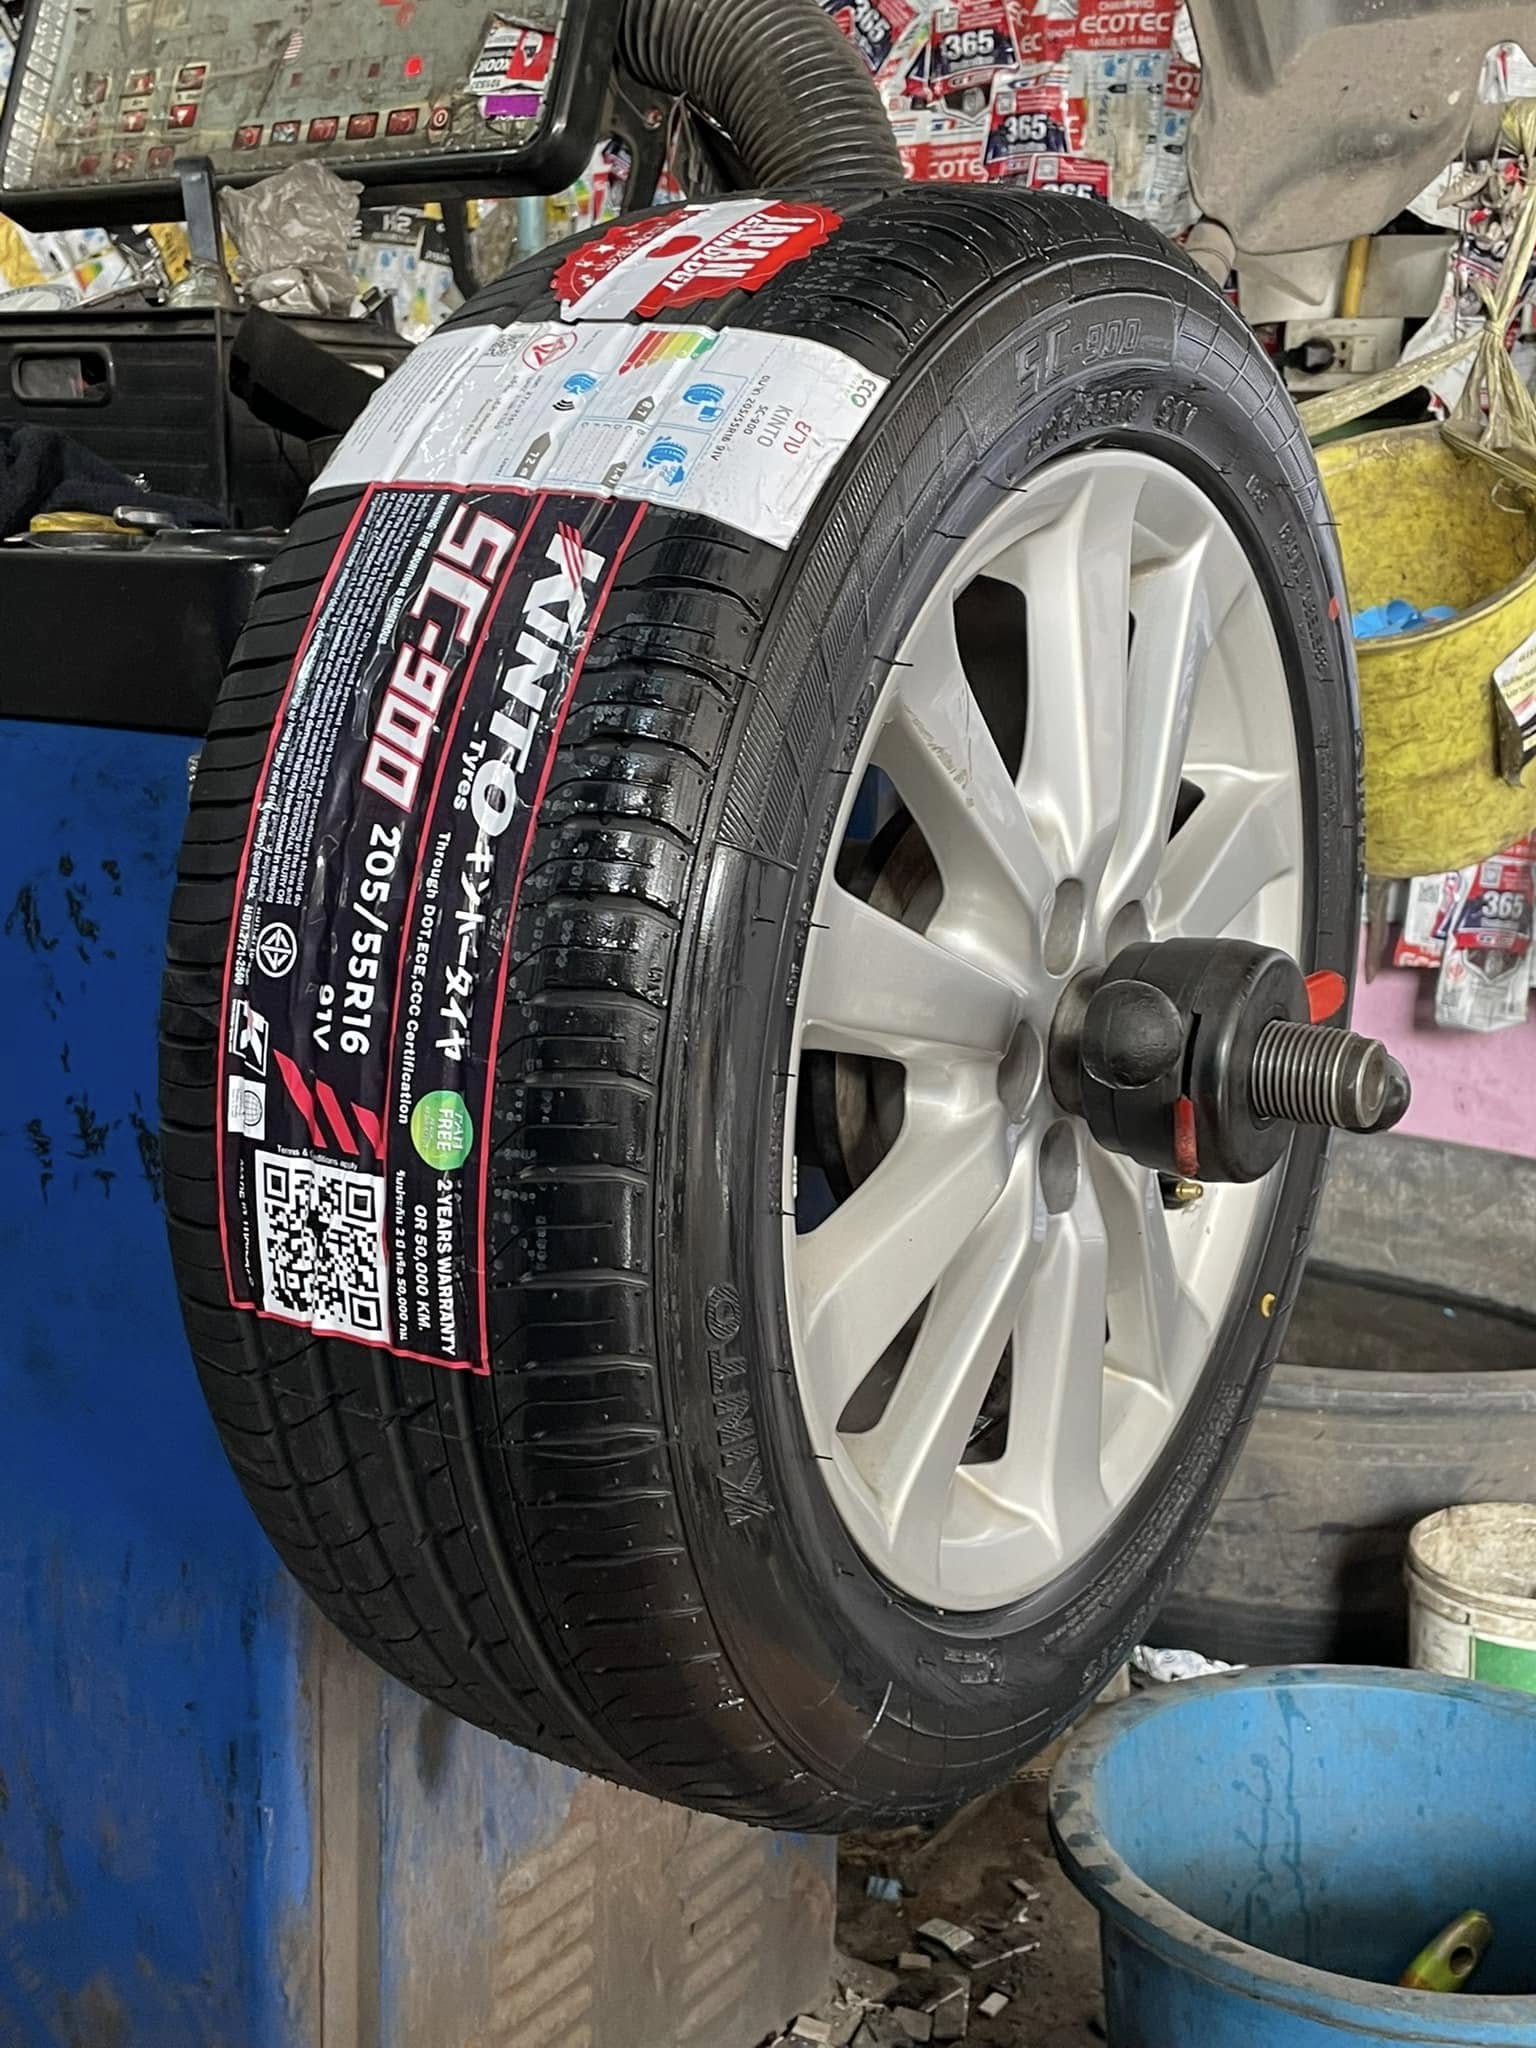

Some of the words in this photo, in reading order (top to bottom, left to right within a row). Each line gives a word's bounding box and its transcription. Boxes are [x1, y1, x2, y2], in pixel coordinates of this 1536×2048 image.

[1080, 12, 1171, 34] ECOTEC
[943, 29, 995, 61] 365
[1004, 114, 1047, 143] 365
[661, 212, 772, 293] TECHNOLOGY
[694, 212, 817, 278] JAPAN
[850, 378, 877, 408] ECO
[721, 397, 756, 444] 205/55R16
[743, 404, 769, 435] SC-900
[756, 404, 794, 448] KINTO
[711, 445, 727, 462] 91V
[426, 491, 449, 532] WARNING:
[417, 529, 433, 549] TIRE
[399, 546, 425, 589] MOUNTING
[353, 597, 367, 617] with
[376, 595, 403, 645] DANGEROUS
[356, 630, 371, 652] Only
[361, 502, 517, 814] SC-900
[330, 655, 345, 679] force
[471, 521, 606, 837] KINTO
[306, 682, 325, 718] possible
[317, 678, 337, 719] sufficient
[327, 663, 349, 713] procedures
[332, 685, 352, 726] personal
[281, 720, 294, 742] hose
[296, 717, 314, 754] damage
[306, 729, 319, 757] cause
[321, 713, 335, 739] could
[324, 725, 339, 753] using
[272, 750, 285, 769] stay
[292, 753, 304, 771] that
[313, 738, 326, 765] cause
[319, 753, 332, 777] tools
[296, 757, 313, 799] SERIOUS
[305, 765, 320, 792] faulty
[453, 739, 488, 812] Tyres
[282, 791, 294, 814] have
[294, 792, 313, 842] positioning
[274, 813, 289, 854] occurred
[284, 799, 302, 852] PERSONAL
[264, 863, 279, 903] shipping
[278, 852, 291, 887] INJURY
[287, 869, 297, 885] tire
[295, 859, 307, 891] should
[426, 832, 451, 899] Through
[246, 875, 258, 900] Back.
[1482, 890, 1524, 919] 365
[340, 822, 401, 1055] 205/55R16
[408, 904, 436, 1017] DOT,ECE,CCC
[313, 984, 335, 1052] 91V
[398, 1019, 419, 1125] Certification
[437, 1108, 454, 1152] FREE
[277, 1144, 300, 1156] Terms
[437, 1179, 453, 1192] 2
[395, 1227, 405, 1237] 2
[414, 1204, 428, 1231] OR
[436, 1193, 453, 1255] YEARS
[413, 1234, 429, 1297] 50,000
[396, 1278, 408, 1322] 50,000
[416, 1300, 431, 1332] KM.
[437, 1255, 456, 1356] WARRANTY
[706, 1281, 775, 1527] KINTO
